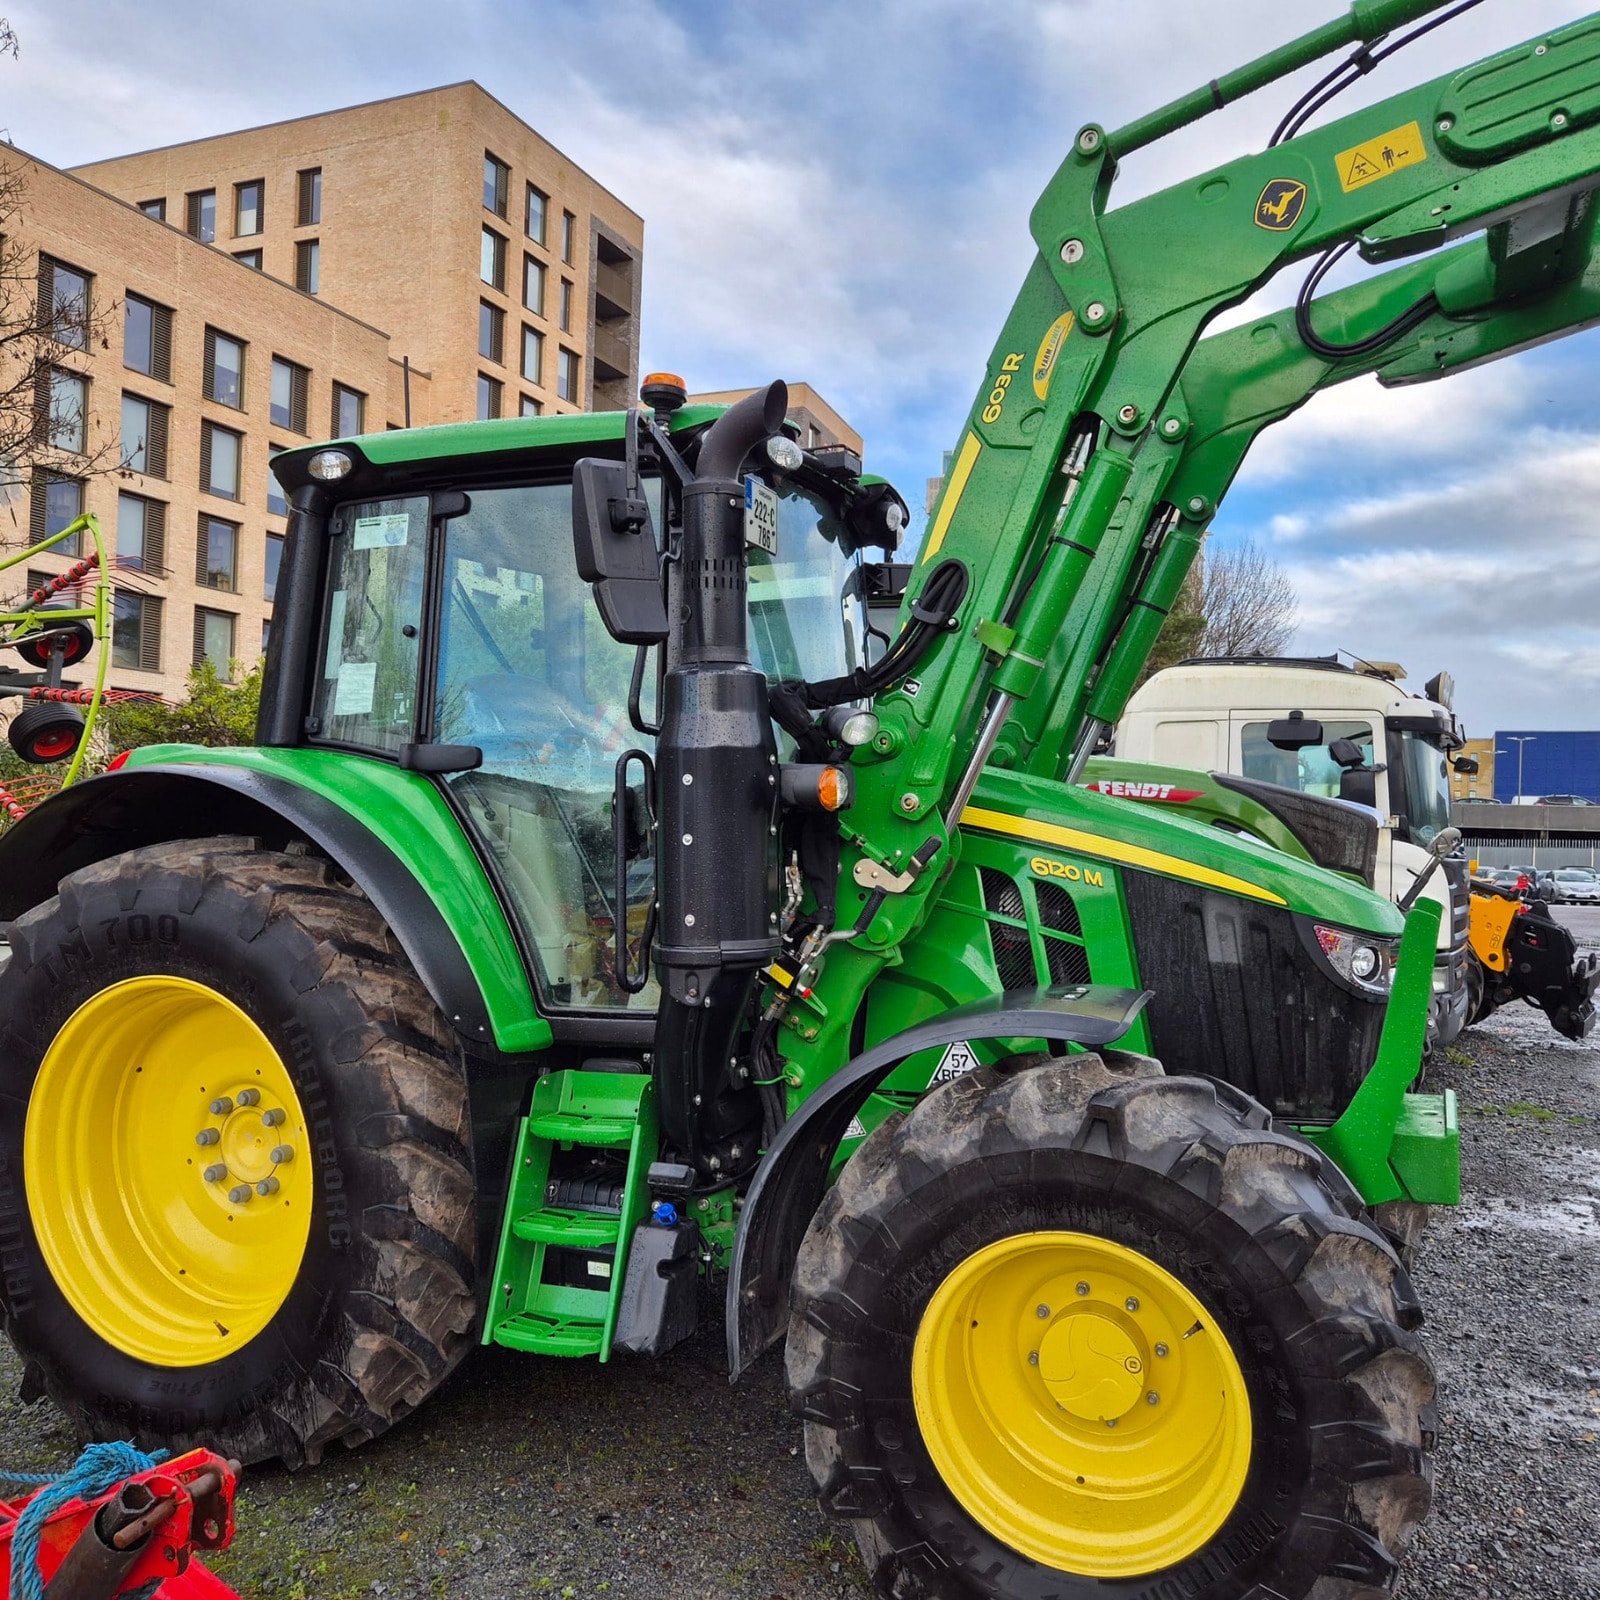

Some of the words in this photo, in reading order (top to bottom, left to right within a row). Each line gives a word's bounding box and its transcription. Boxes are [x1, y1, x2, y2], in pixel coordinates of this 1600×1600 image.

[982, 373, 1012, 424] 603
[1001, 352, 1026, 372] R
[754, 498, 775, 527] 222-C
[757, 524, 771, 549] 786
[1097, 780, 1175, 799] FENDT
[1030, 857, 1081, 881] 6120
[1084, 869, 1104, 887] M
[97, 913, 181, 951] 700
[951, 1053, 968, 1069] 57
